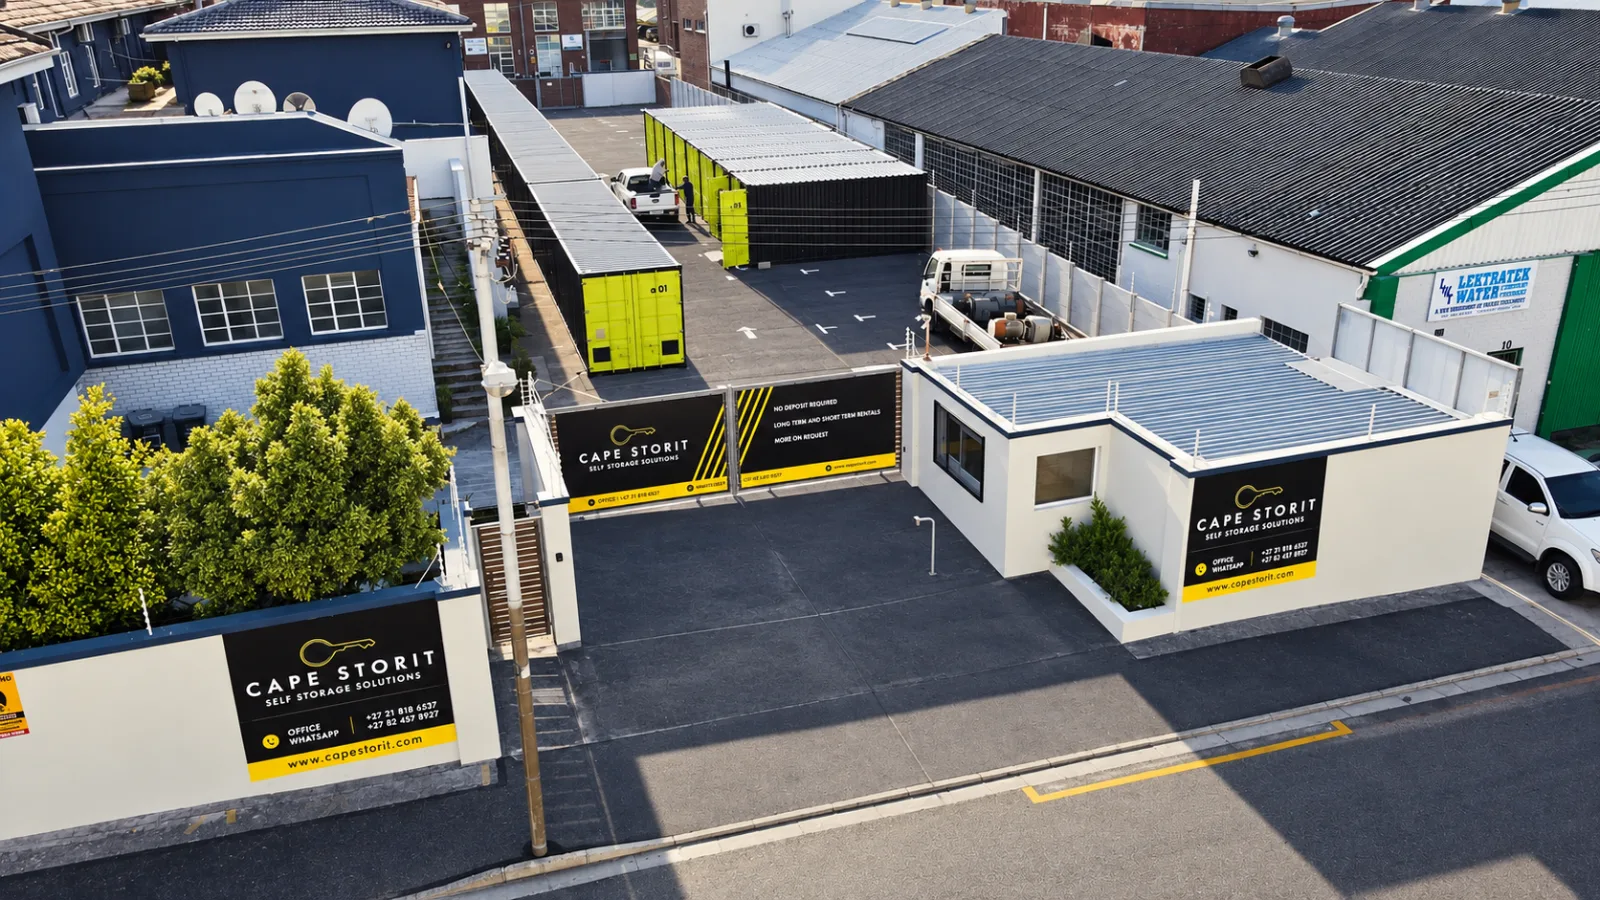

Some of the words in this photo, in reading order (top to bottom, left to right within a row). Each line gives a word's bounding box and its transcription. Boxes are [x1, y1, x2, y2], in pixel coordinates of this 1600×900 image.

[1457, 267, 1531, 289] LEKTRATEK
[658, 284, 667, 293] 01
[1456, 285, 1500, 304] WATER
[1501, 339, 1512, 350] 10
[784, 402, 808, 411] DEPOSIT
[809, 398, 838, 408] REQUIRED
[773, 421, 791, 429] LONG
[792, 418, 807, 426] TERM
[808, 416, 821, 424] AND
[822, 414, 840, 423] SHORT
[841, 411, 856, 420] TERM
[857, 409, 881, 418] RENTALS
[774, 436, 792, 444] MORE
[792, 434, 803, 442] ON
[803, 431, 829, 440] REQUEST
[579, 449, 621, 464] CAPE
[631, 439, 689, 457] STORIT
[589, 464, 605, 473] SELF
[607, 459, 639, 470] STORAGE
[641, 454, 679, 466] SOLUTIONS
[1196, 512, 1243, 532] CAPE
[1253, 498, 1316, 521] STORIT
[1205, 531, 1222, 541] SELF
[1225, 524, 1259, 537] STORAGE
[1261, 516, 1305, 530] SOLUTIONS
[1212, 556, 1234, 566] OFFICE
[1212, 562, 1244, 573] WHATSAPP
[1206, 569, 1294, 594] www.capestorit.com
[246, 671, 320, 697] CAPE
[337, 650, 435, 681] STORIT
[265, 695, 292, 707] SELF
[296, 685, 351, 702] STORAGE
[355, 671, 421, 691] SOLUTIONS
[366, 711, 382, 721] +27
[384, 709, 395, 718] 21
[398, 705, 414, 715] 818
[416, 701, 437, 712] 6537
[367, 721, 384, 730] +27
[386, 718, 398, 727] 82
[399, 714, 415, 725] 457
[418, 710, 439, 721] 8927
[287, 722, 321, 737] OFFICE
[289, 729, 340, 746] WHATSAPP
[287, 735, 423, 769] www.capestorit.com
